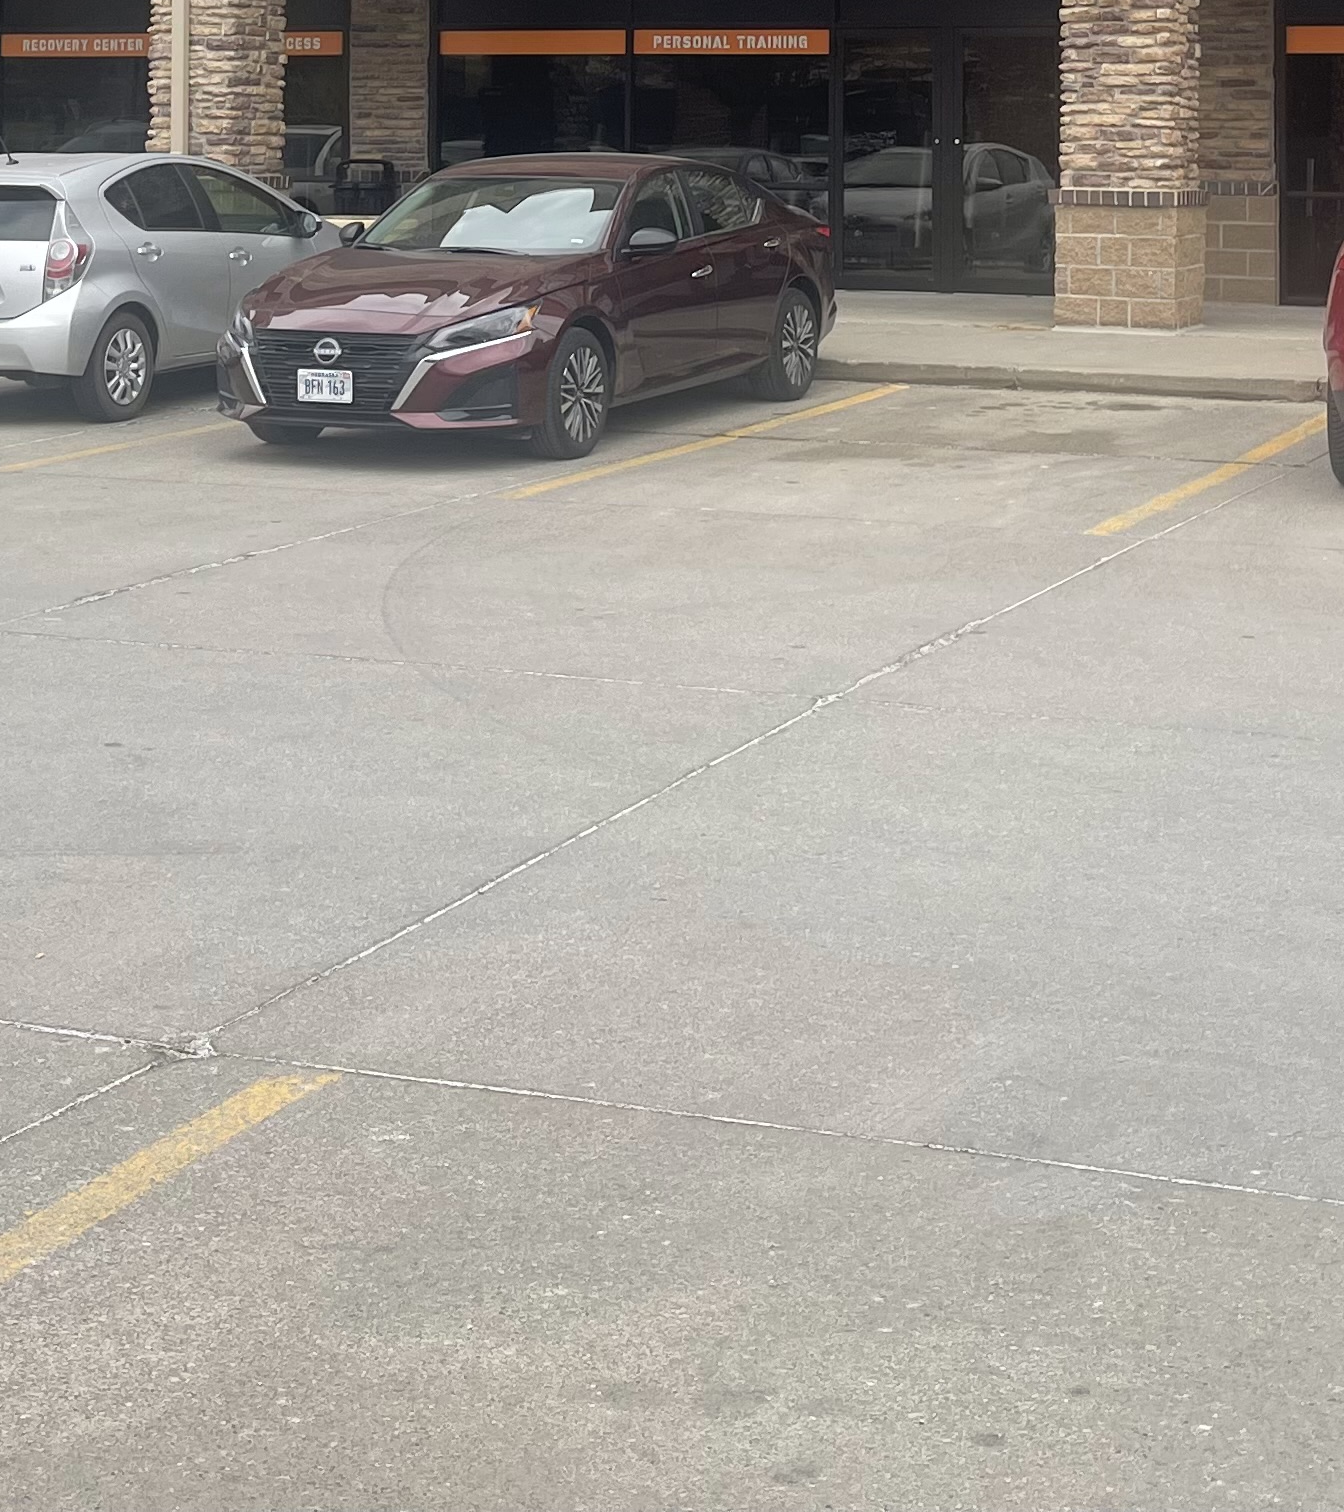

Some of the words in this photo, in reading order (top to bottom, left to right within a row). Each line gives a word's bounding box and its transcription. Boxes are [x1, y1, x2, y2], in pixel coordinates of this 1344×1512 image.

[22, 38, 88, 52] RECOVERY
[93, 37, 144, 52] CENTER
[652, 34, 731, 49] PERSONAL
[736, 34, 808, 49] TRAINING
[304, 378, 324, 395] BFN
[327, 379, 345, 396] 163
